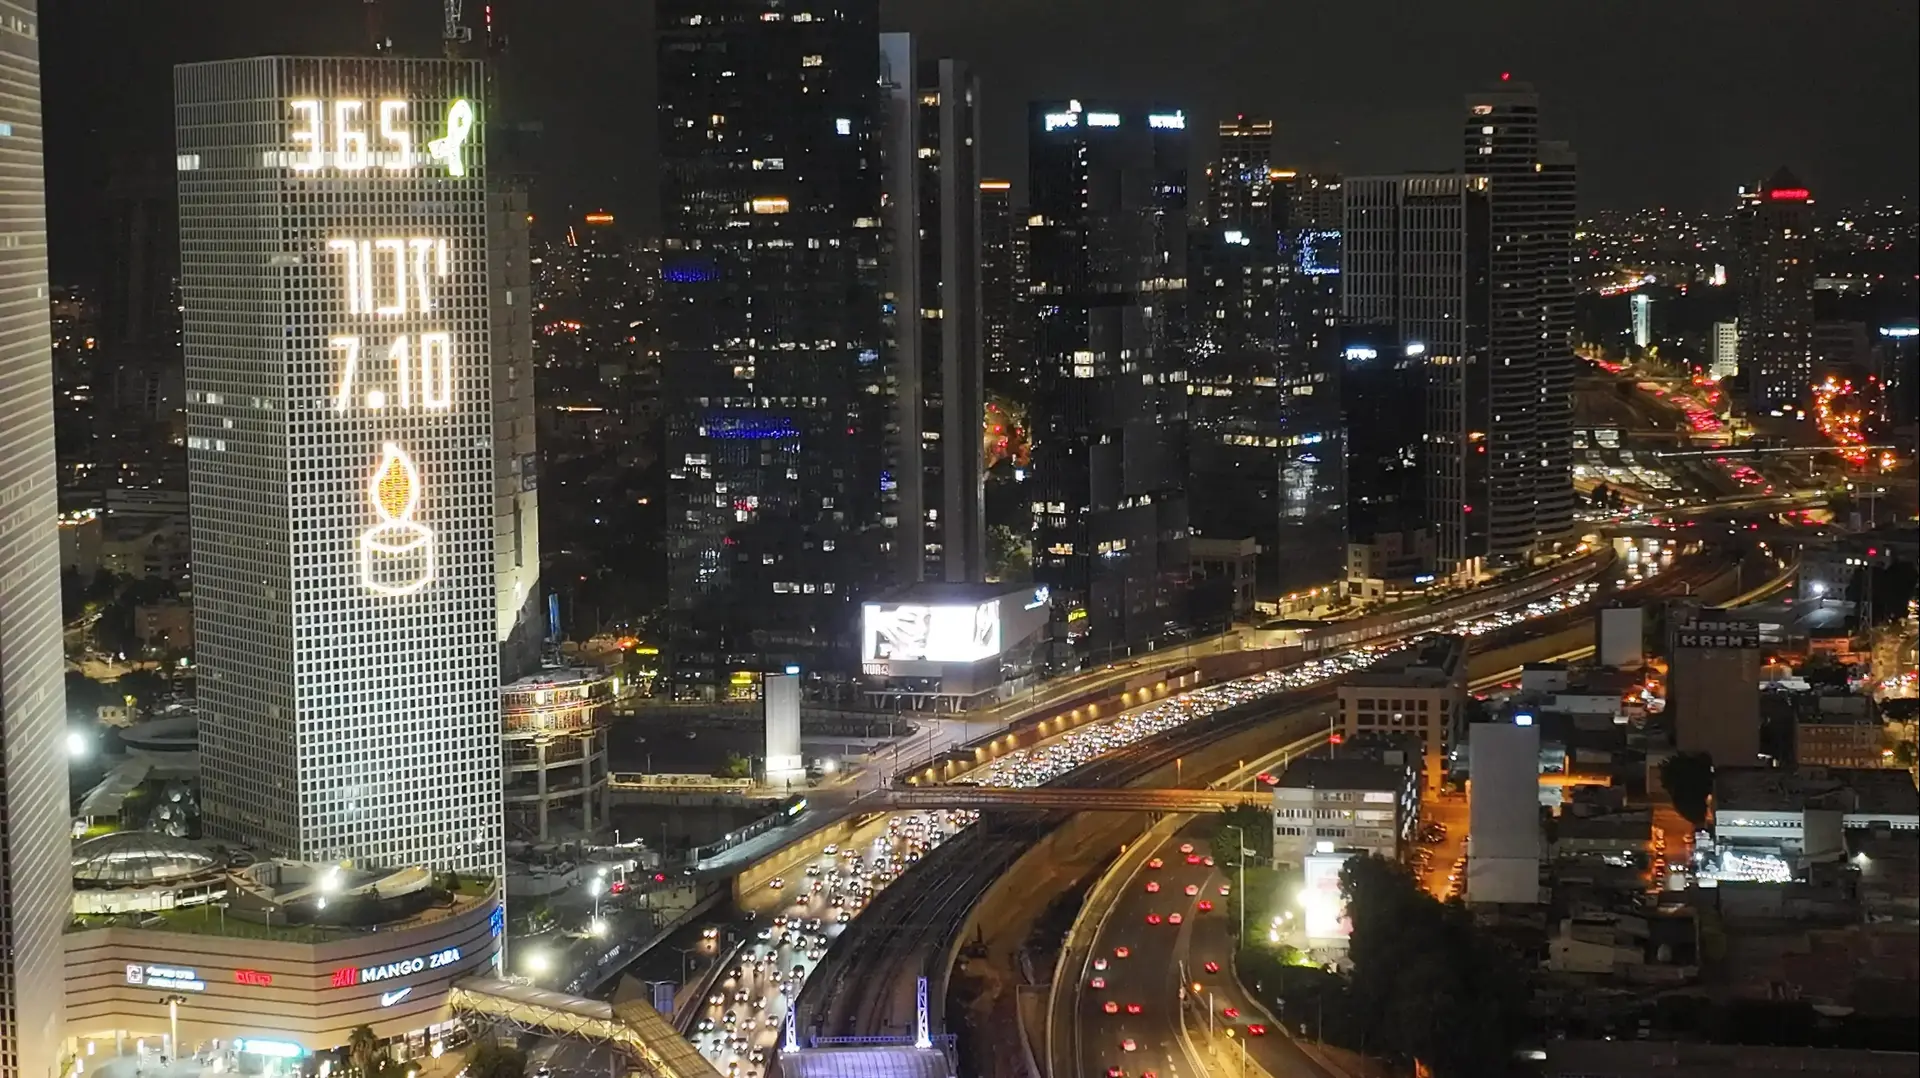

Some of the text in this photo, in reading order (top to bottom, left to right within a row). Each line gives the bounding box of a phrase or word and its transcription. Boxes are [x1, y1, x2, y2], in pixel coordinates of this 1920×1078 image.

[289, 99, 413, 171] 365
[328, 238, 449, 316] יזכור
[329, 333, 451, 415] 7.10
[361, 957, 425, 983] MANGO
[428, 948, 461, 969] ZARA
